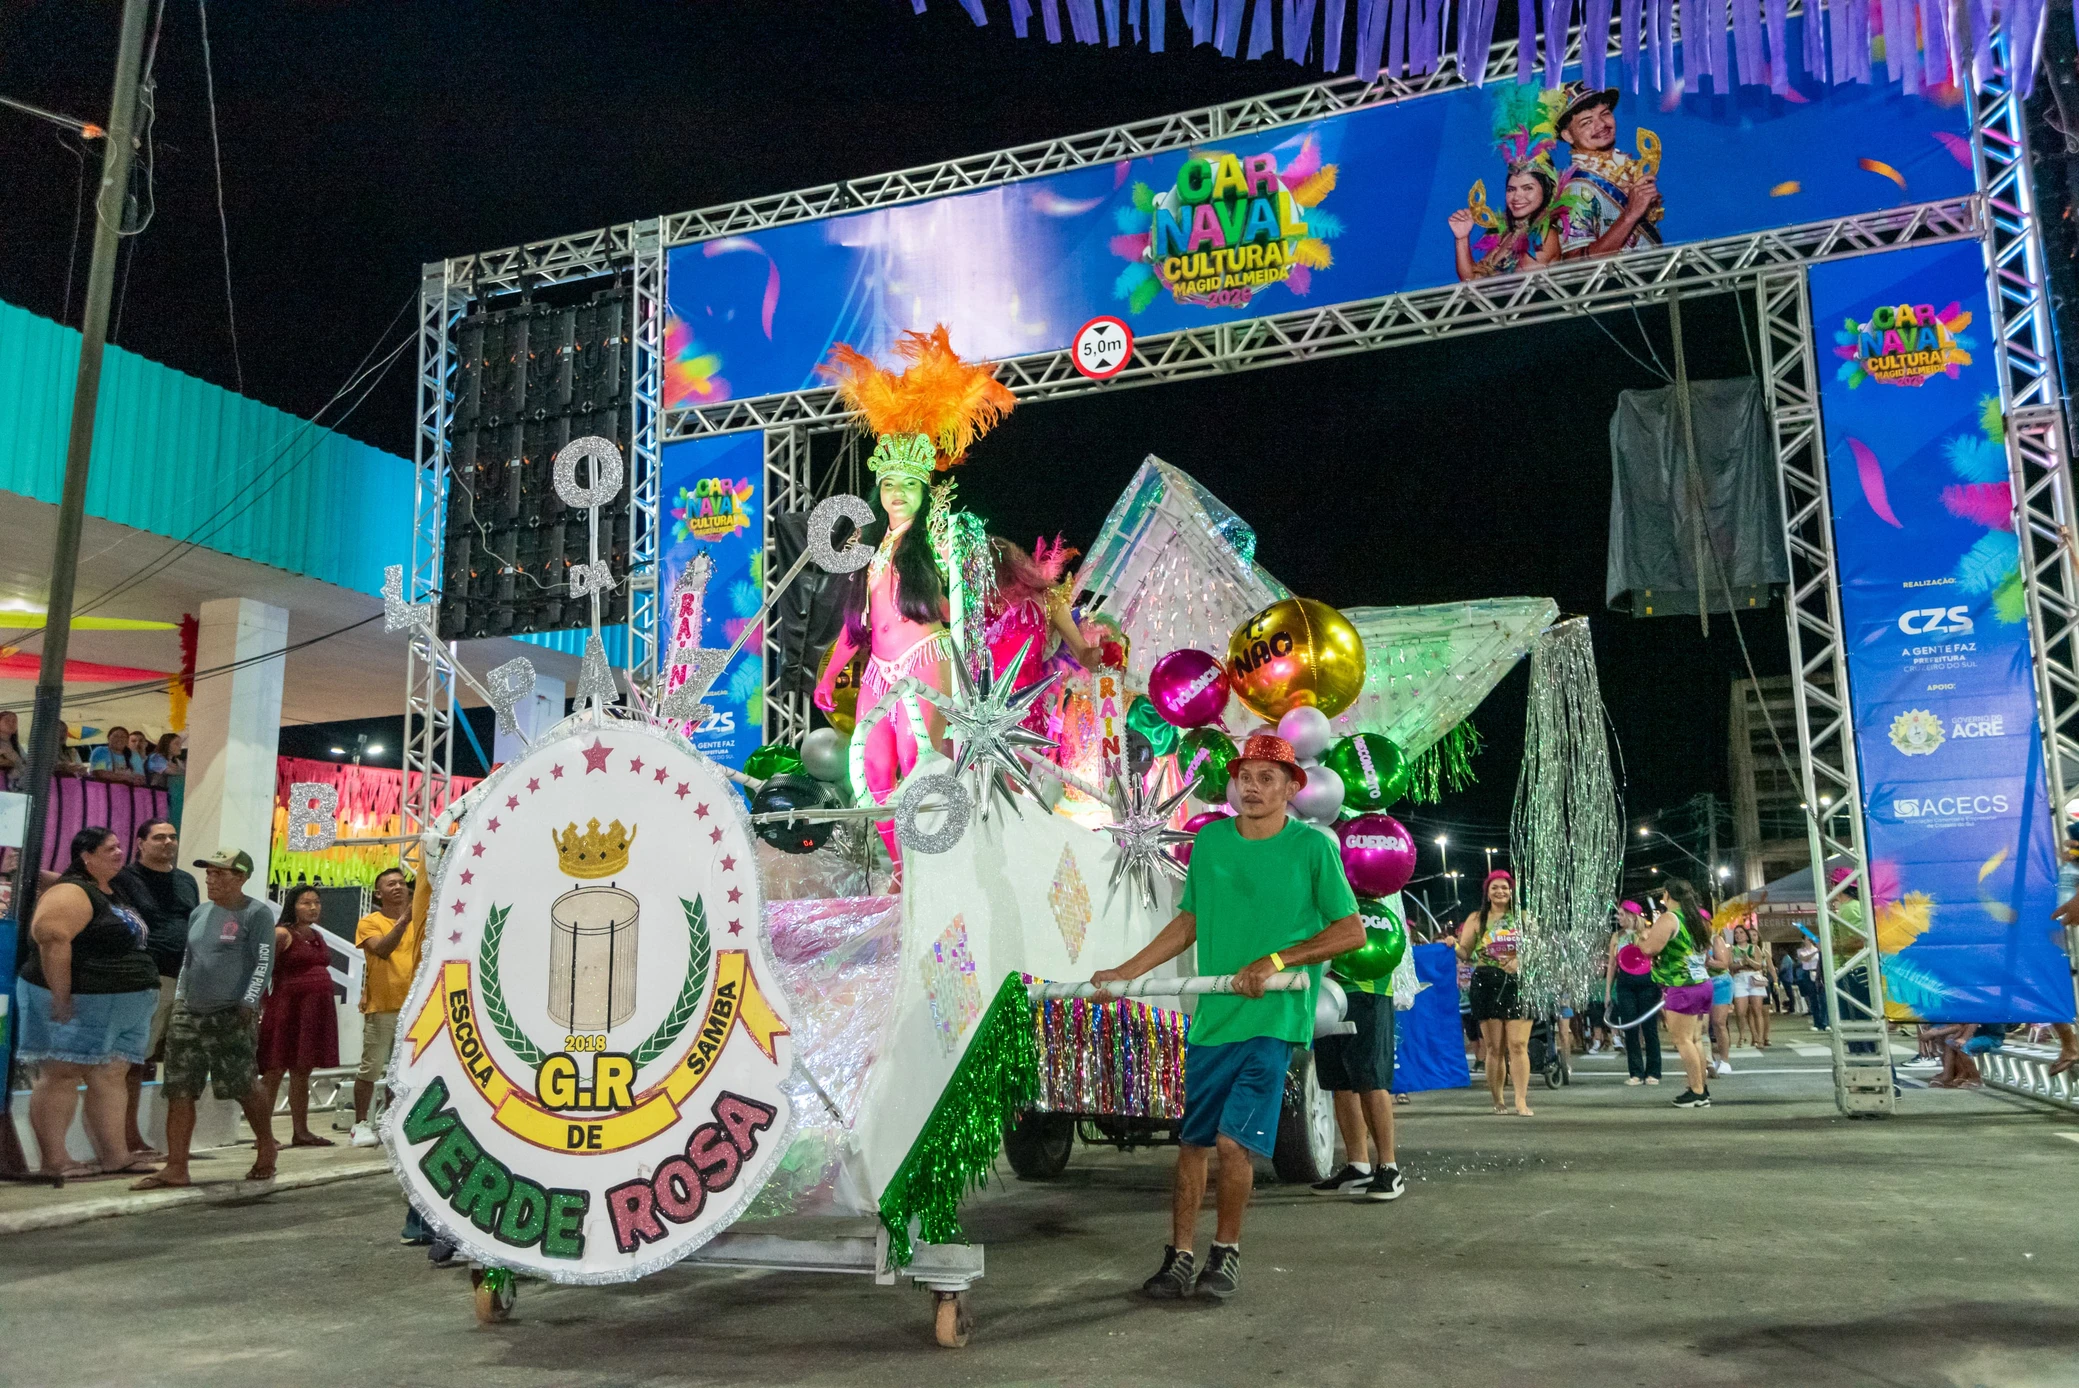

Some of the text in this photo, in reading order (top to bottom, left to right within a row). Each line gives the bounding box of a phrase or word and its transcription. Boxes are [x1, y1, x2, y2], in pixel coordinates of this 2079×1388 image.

[1177, 153, 1279, 201] CAR
[1155, 192, 1308, 256] NAVAL
[1163, 240, 1300, 281] CULTURAL
[1172, 265, 1290, 298] MAGID ALMEIDA
[1206, 287, 1253, 308] 2026
[1872, 303, 1937, 330] CAR
[1084, 340, 1121, 357] 5,0m
[1860, 324, 1957, 358] NAVAL
[1867, 349, 1950, 372] CULTURAL
[1874, 364, 1947, 380] MAGID ALMEIDA
[696, 477, 733, 498] CAR
[687, 494, 743, 518] NAVAL
[690, 514, 739, 530] CULTURAL
[569, 560, 617, 599] DA
[1902, 577, 1957, 588] REALIZAÇÃO:
[1898, 605, 1974, 635] CZS
[1234, 631, 1293, 679] NÃO
[1902, 643, 1977, 656] A GENTE FAZ
[1913, 655, 1966, 664] PREFEITURA
[1903, 663, 1946, 673] CRUZEIRO
[1167, 665, 1222, 712] VIOLÊNCIA
[1926, 683, 1957, 691] APOIO:
[695, 712, 735, 733] ZS
[1951, 715, 1989, 724] GOVERNO
[1951, 721, 2005, 739] ACRE
[697, 741, 721, 749] GENTE
[1920, 795, 2009, 816] ACECS
[1346, 834, 1409, 853] GUERRA
[1361, 914, 1394, 932] OGA
[259, 943, 270, 961] AQUI
[253, 962, 269, 978] TEM
[686, 980, 737, 1075] SAMBA
[449, 988, 496, 1089] ESCOLA
[564, 1034, 607, 1053] 2018
[536, 1052, 637, 1112] G.R
[567, 1124, 603, 1150] DE
[403, 1076, 590, 1260] VERDE
[605, 1090, 778, 1254] ROSA
